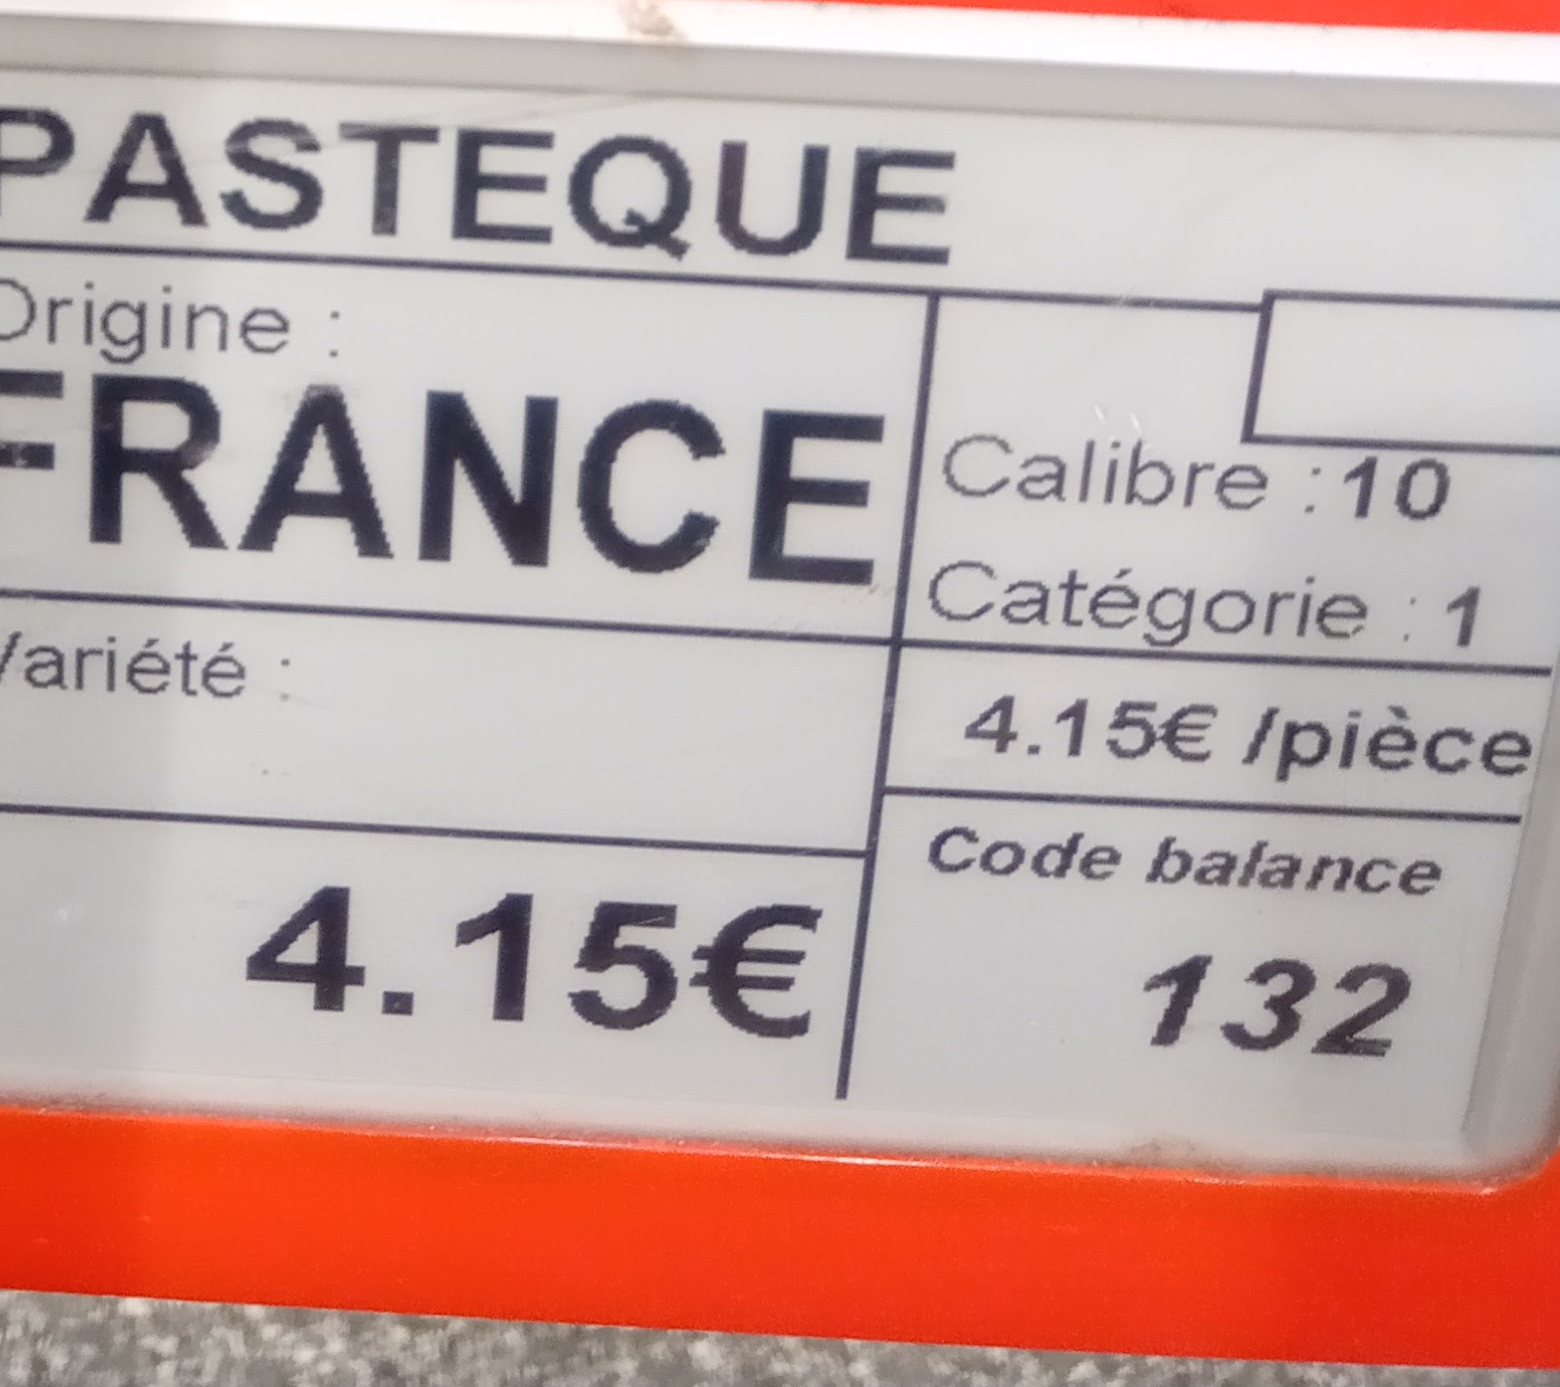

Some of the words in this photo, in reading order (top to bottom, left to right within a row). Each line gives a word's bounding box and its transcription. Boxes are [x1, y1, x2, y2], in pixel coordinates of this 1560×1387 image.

[942, 433, 1270, 511] Calibre
[928, 560, 1368, 648] Catégorie
[964, 695, 1218, 763] 4.15€
[1242, 705, 1533, 784] /pièce
[927, 827, 1122, 881] Code
[1145, 836, 1443, 897] balance
[245, 885, 824, 1040] 4.15€
[1143, 955, 1412, 1058] 132
